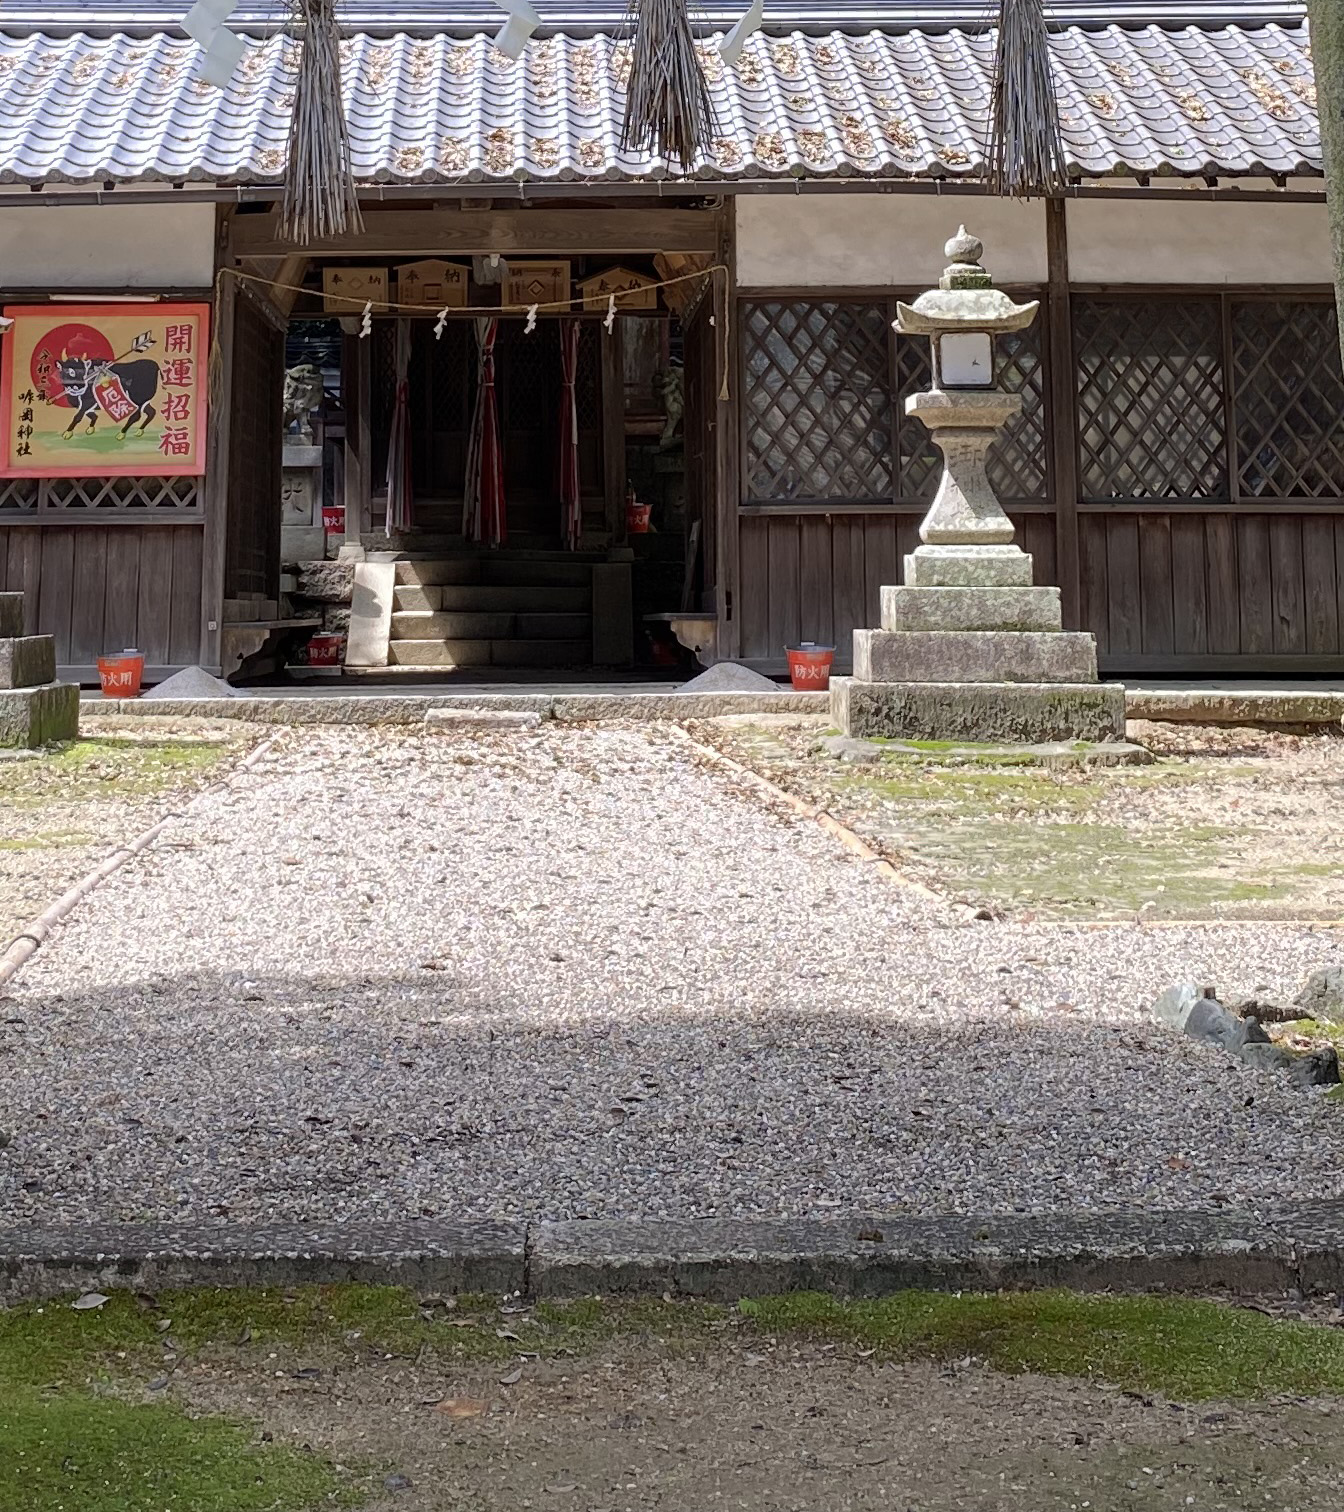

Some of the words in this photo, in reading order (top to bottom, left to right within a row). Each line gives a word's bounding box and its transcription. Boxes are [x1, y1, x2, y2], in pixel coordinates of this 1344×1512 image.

[102, 386, 134, 419] 厄除
[158, 323, 194, 457] 開運招福
